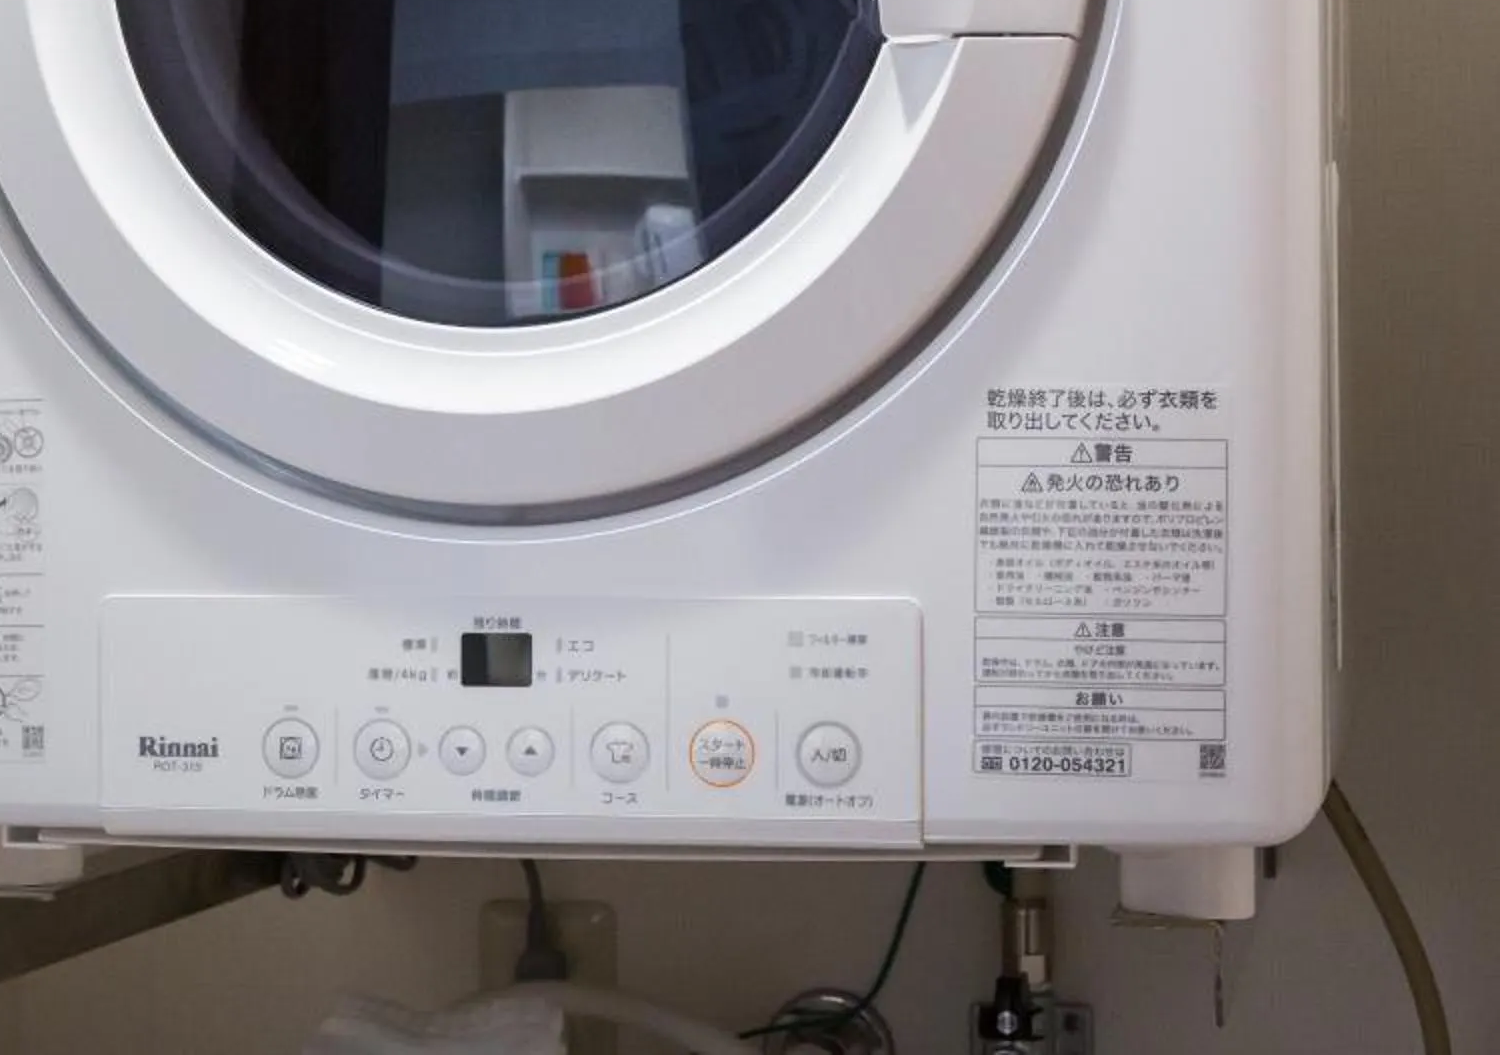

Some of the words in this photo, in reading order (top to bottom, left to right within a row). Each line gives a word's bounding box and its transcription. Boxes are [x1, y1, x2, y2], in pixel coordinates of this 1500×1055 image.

[987, 389, 1218, 411] 乾燥終了後は、必ず衣類を
[987, 412, 1161, 432] 取り出してください。
[1095, 443, 1133, 463] 警告
[1047, 474, 1180, 494] 発火の恐れあり
[1095, 623, 1126, 639] 注意
[567, 640, 595, 652] エコ
[567, 669, 627, 683] デリケート
[1075, 692, 1124, 706] お願い
[138, 736, 219, 758] Rinnai
[698, 737, 745, 752] スタート
[1009, 756, 1126, 774] 0120-054321
[358, 788, 405, 800] タイマー
[600, 791, 638, 804] コース
